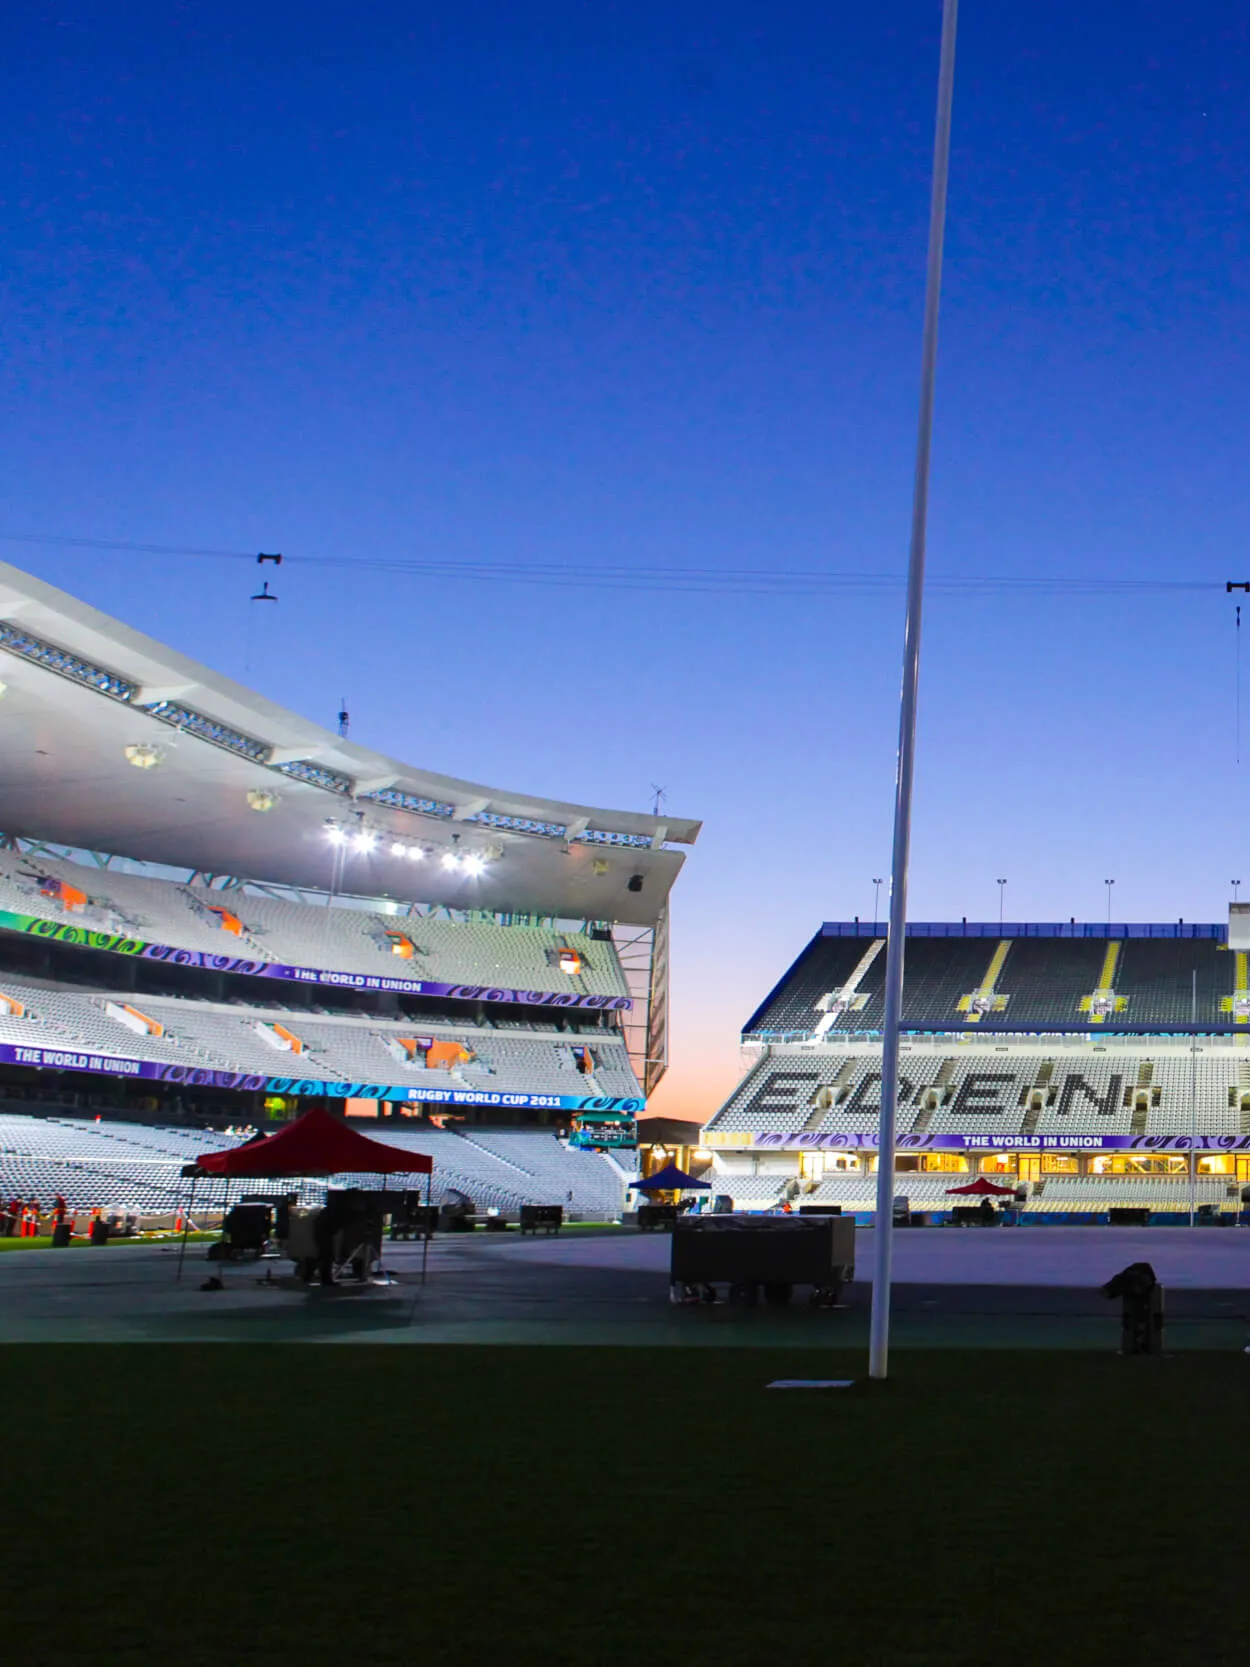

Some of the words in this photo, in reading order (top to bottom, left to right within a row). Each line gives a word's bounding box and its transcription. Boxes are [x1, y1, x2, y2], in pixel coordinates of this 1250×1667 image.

[366, 977, 379, 988] IN
[381, 979, 422, 992] UNION
[14, 1048, 41, 1063] THE
[43, 1051, 88, 1067] WORLD
[89, 1057, 103, 1070] IN
[104, 1058, 141, 1074] UNION
[408, 1088, 451, 1101] RUGBY
[453, 1091, 500, 1104] WORLD
[502, 1094, 529, 1105] CUP
[530, 1095, 561, 1106] 2011
[963, 1136, 990, 1147] THE
[992, 1136, 1041, 1147] WORLD
[1043, 1136, 1057, 1147] IN
[1060, 1137, 1103, 1147] UNION
